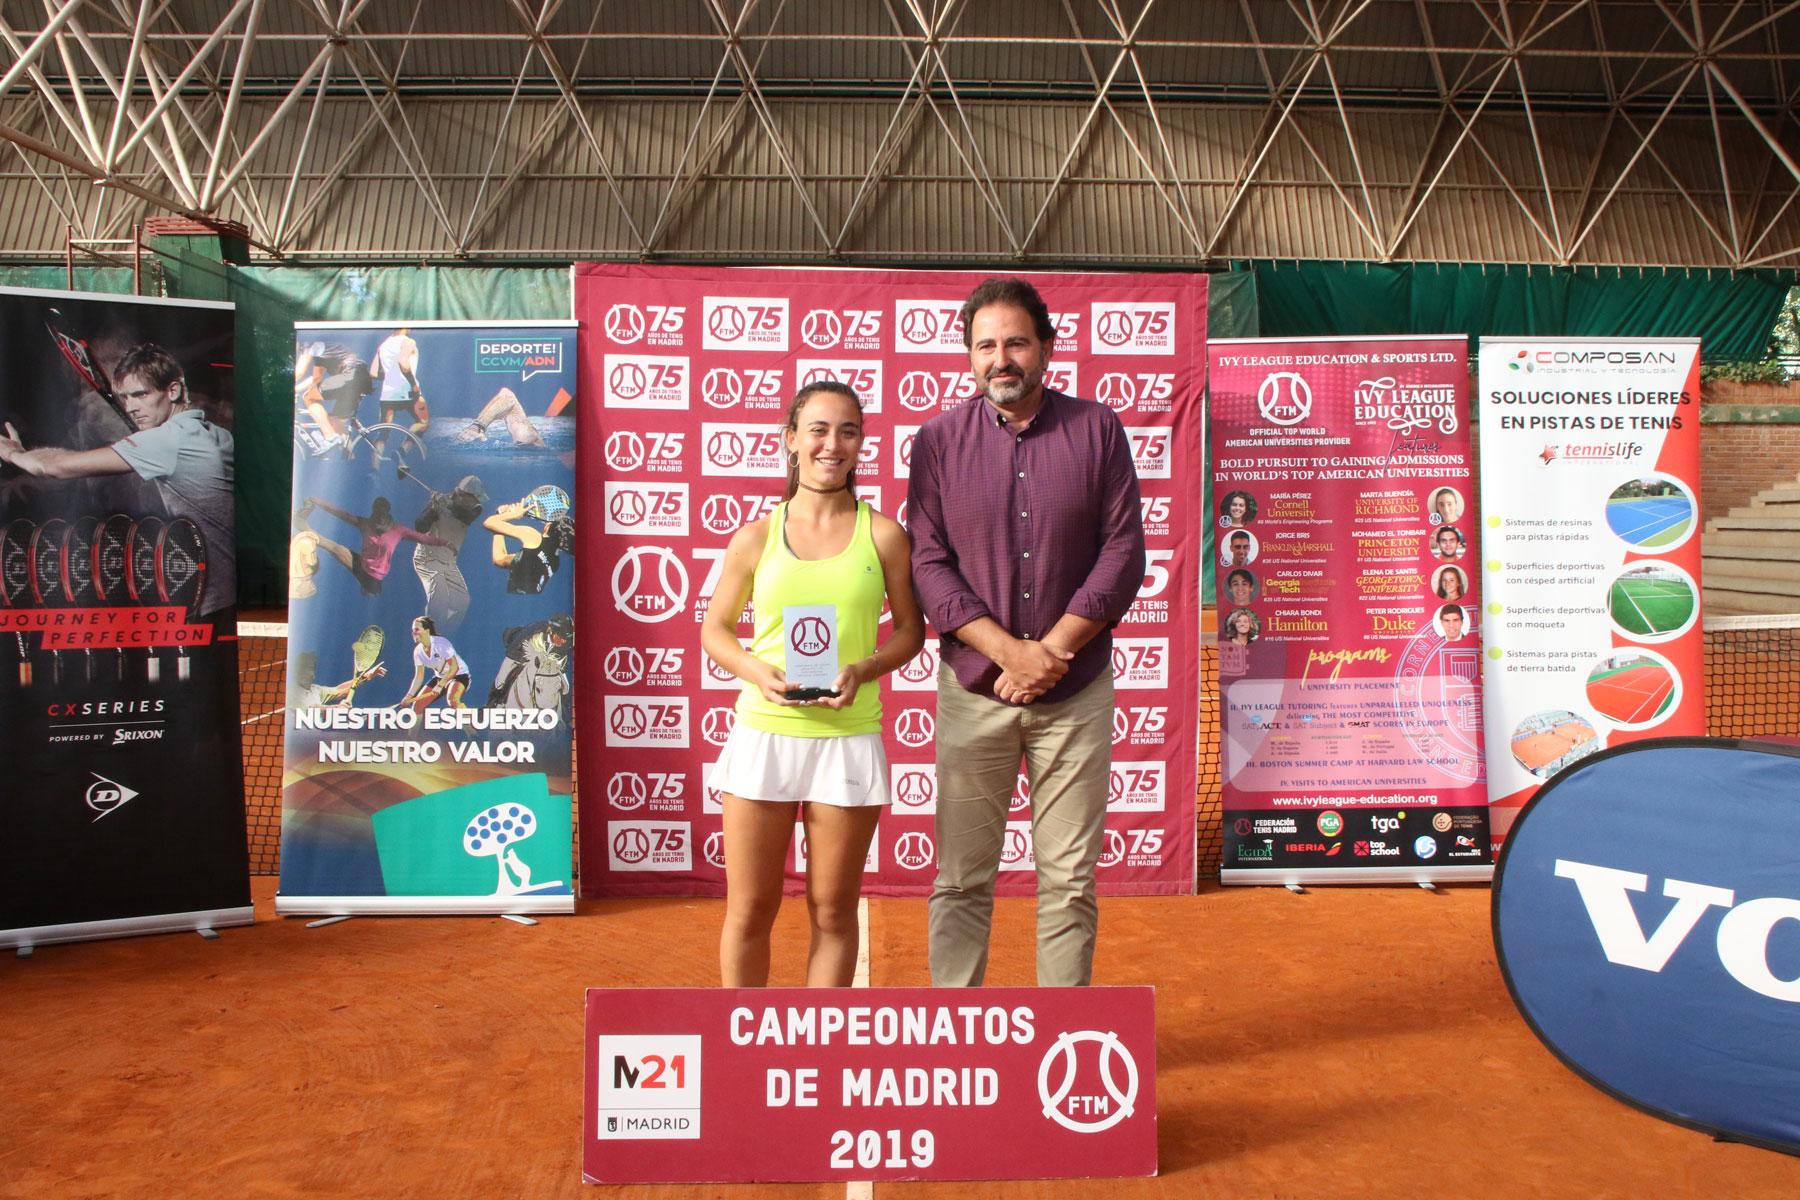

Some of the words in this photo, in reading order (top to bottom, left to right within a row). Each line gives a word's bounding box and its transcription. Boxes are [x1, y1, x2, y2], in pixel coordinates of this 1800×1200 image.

[646, 306, 686, 332] 75
[747, 306, 783, 330] 75
[843, 310, 883, 337] 75
[1134, 311, 1169, 334] 75
[616, 329, 633, 337] FTM
[812, 334, 830, 342] FTM
[480, 343, 556, 354] DEPORTE!
[481, 356, 555, 367] CCVM/ADN
[1219, 357, 1241, 367] IVY
[1243, 356, 1293, 366] LEAGUE
[1296, 355, 1369, 365] EDUCATION
[1371, 355, 1381, 363] &
[1383, 354, 1428, 363] SPORTS
[1430, 353, 1456, 363] LTD.
[1535, 351, 1675, 364] COMPOSAN
[1392, 390, 1455, 404] LEAGUE
[1491, 391, 1612, 405] SOLUCIONES
[1617, 387, 1691, 405] LÍDERES
[1274, 407, 1296, 416] FTM
[1501, 416, 1525, 430] EN
[1530, 416, 1596, 430] PISTAS
[1600, 416, 1625, 430] DE
[1629, 416, 1683, 430] TENIS
[1249, 428, 1282, 436] OFFICIAL
[1284, 428, 1297, 436] TOP
[1565, 442, 1643, 459] tennislife
[1221, 458, 1254, 469] BOLD
[1257, 458, 1308, 468] PURSUIT
[1311, 458, 1327, 467] TO
[1330, 457, 1388, 467] GAINING
[1390, 455, 1464, 465] ADMISSIONS
[1215, 472, 1229, 481] IN
[1292, 470, 1314, 480] TOP
[1317, 469, 1385, 480] AMERICAN
[1387, 468, 1470, 479] UNIVERSITIES
[1274, 500, 1309, 509] Cornell
[1355, 504, 1419, 515] RICHMOND
[1267, 508, 1315, 518] University
[1505, 518, 1545, 527] Sistemas
[1547, 518, 1558, 527] de
[1560, 519, 1593, 527] resinas
[1358, 537, 1420, 548] PRINCETON
[1505, 534, 1526, 542] para
[1528, 533, 1554, 542] pistas
[1556, 532, 1590, 542] rápidas
[1358, 547, 1420, 557] UNIVERSITY
[1506, 562, 1555, 572] Superficies
[1556, 562, 1606, 571] deportivas
[1266, 579, 1300, 587] Georgia
[1355, 575, 1427, 586] GEORGETOWN
[1524, 576, 1556, 586] césped
[1558, 577, 1595, 585] artificial
[1362, 584, 1420, 594] UNIVERSITY
[634, 595, 666, 610] FTM
[1142, 601, 1169, 610] TENIS
[1506, 606, 1555, 615] Superficies
[1557, 606, 1606, 615] deportivas
[0, 612, 118, 627] JOURNEY
[131, 611, 177, 624] FOR
[1121, 611, 1169, 623] MADRID
[1268, 616, 1328, 631] Hamilton
[1372, 615, 1416, 631] Duke
[1525, 620, 1566, 630] moqueta
[51, 628, 206, 645] PERFECTION
[803, 642, 819, 650] FTM
[1506, 650, 1547, 659] Sistemas
[1548, 651, 1569, 660] para
[1571, 650, 1598, 660] pistas
[1300, 646, 1392, 688] programs
[1506, 664, 1518, 673] de
[1521, 664, 1545, 672] tierra
[1547, 664, 1576, 672] batida
[295, 707, 417, 731] NUESTRO
[422, 707, 558, 731] ESFUERZO
[49, 734, 90, 743] POWERED
[92, 733, 104, 742] BY
[318, 740, 442, 764] NUESTRO
[447, 740, 535, 764] VALOR
[1273, 794, 1438, 808] www.ivyleague-education.org
[1255, 817, 1295, 826] FEDERACIÓN
[1320, 818, 1340, 827] PGA
[1370, 815, 1400, 833] tga
[1253, 826, 1272, 834] TENIS
[1273, 826, 1297, 834] MADRID
[650, 829, 685, 851] 75
[1127, 829, 1165, 854] 75
[1370, 840, 1386, 849] top
[1285, 843, 1326, 852] IBERIA
[1370, 847, 1400, 856] school
[624, 850, 639, 858] FTM
[729, 1006, 1035, 1046] CAMPEONATOS
[613, 1055, 686, 1090] M21
[766, 1068, 818, 1108] DE
[843, 1068, 998, 1107] MADRID
[1068, 1096, 1109, 1116] FTM
[626, 1117, 690, 1131] MADRID
[830, 1129, 935, 1169] 2019
